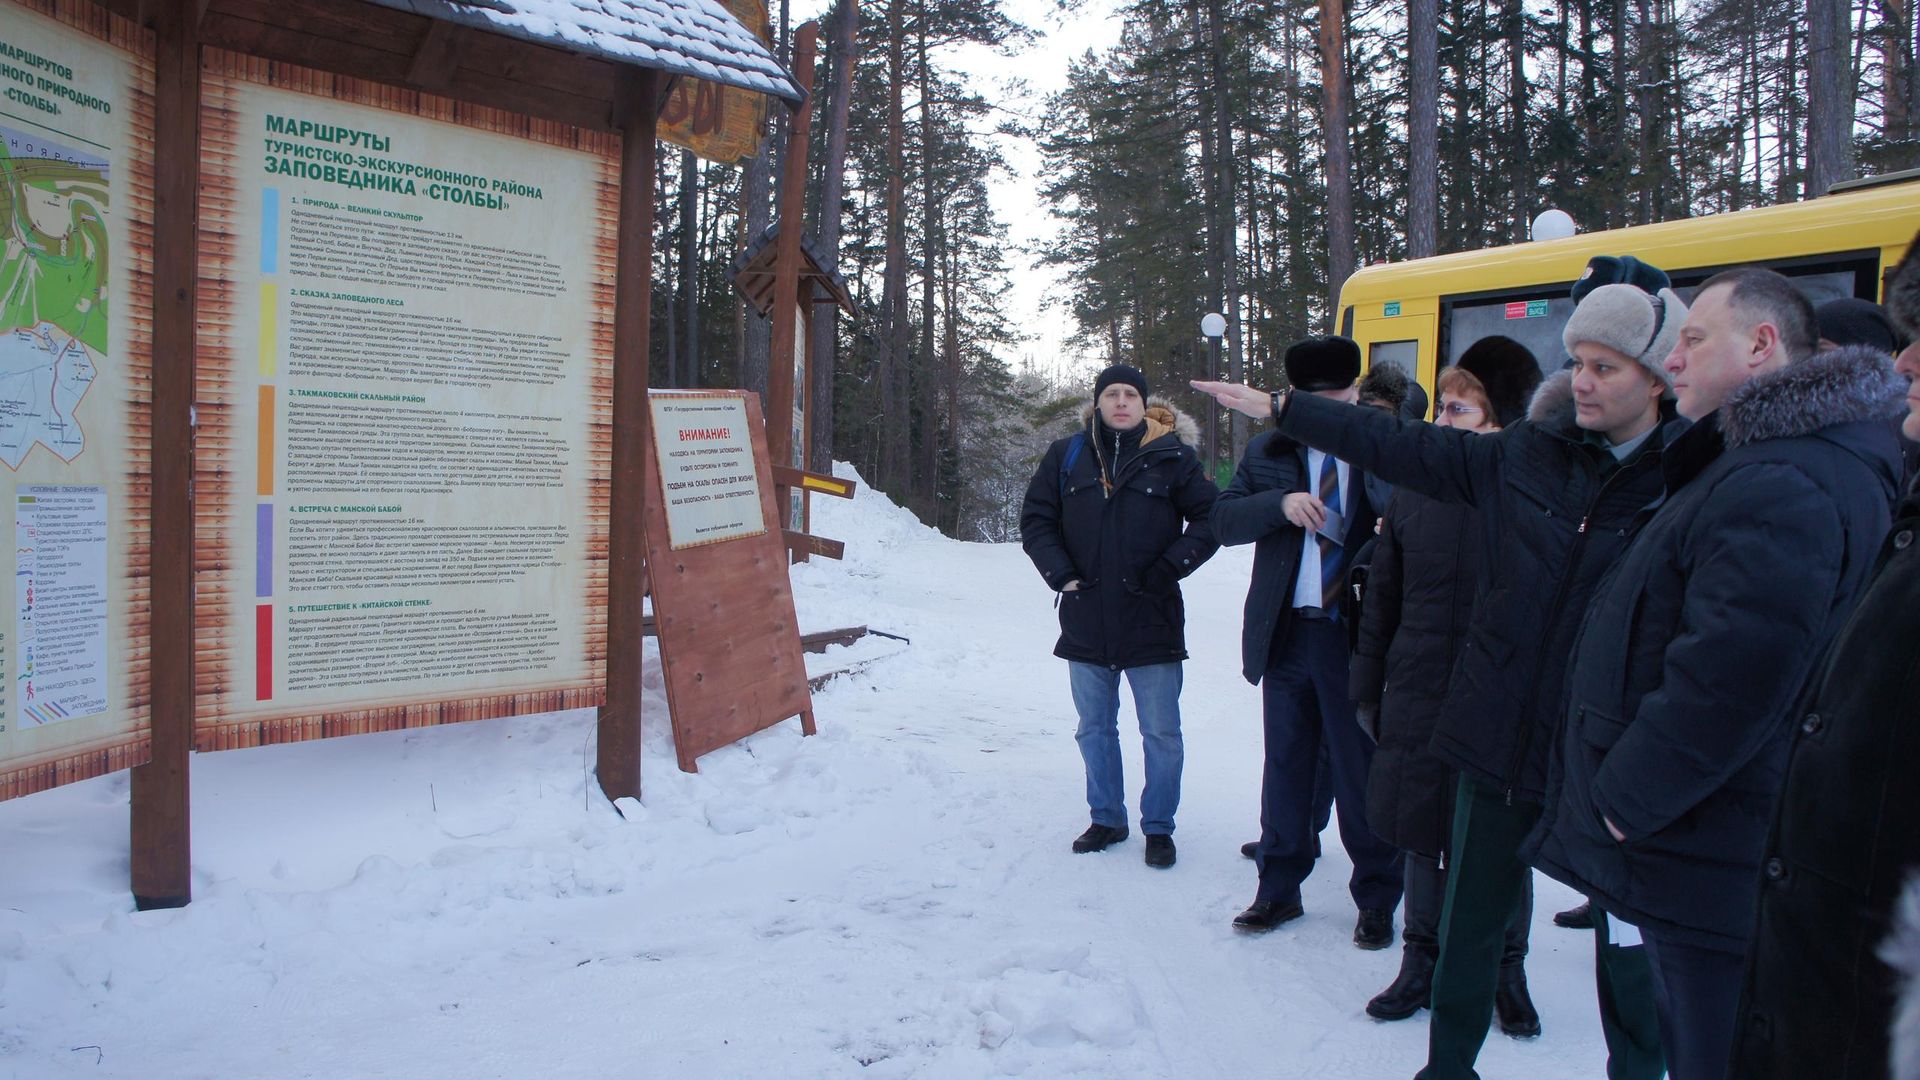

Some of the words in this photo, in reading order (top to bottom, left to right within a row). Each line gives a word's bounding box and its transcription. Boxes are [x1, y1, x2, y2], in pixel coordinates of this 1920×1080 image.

[3, 88, 61, 115] «СТОЛБЫ»
[37, 77, 111, 113] ПРИРОДНОГО
[266, 114, 390, 152] МАРШРУТЫ
[265, 140, 487, 188] ТУРИСТСКО-ЭКСКУРСИОННОГО
[492, 180, 542, 199] РАЙОНА
[265, 157, 416, 196] ЗАПОВЕДНИКА
[422, 183, 509, 210] «СТОЛБЫ»
[303, 199, 338, 210] ПРИРОДА
[347, 204, 381, 216] ВЕЛИКИЙ
[383, 211, 423, 222] СКУЛЬПТОР
[300, 290, 330, 298] СКАЗКА
[332, 293, 384, 304] ЗАПОВЕДНОГО
[298, 389, 358, 399] ТАКМАКОВСКИЙ
[360, 392, 400, 401] СКАЛЬНЫЙ
[402, 394, 425, 403] РАЙОН
[680, 428, 730, 441] ВНИМАНИЕ!
[297, 603, 350, 612] ПУТЕШЕСТВИЕ
